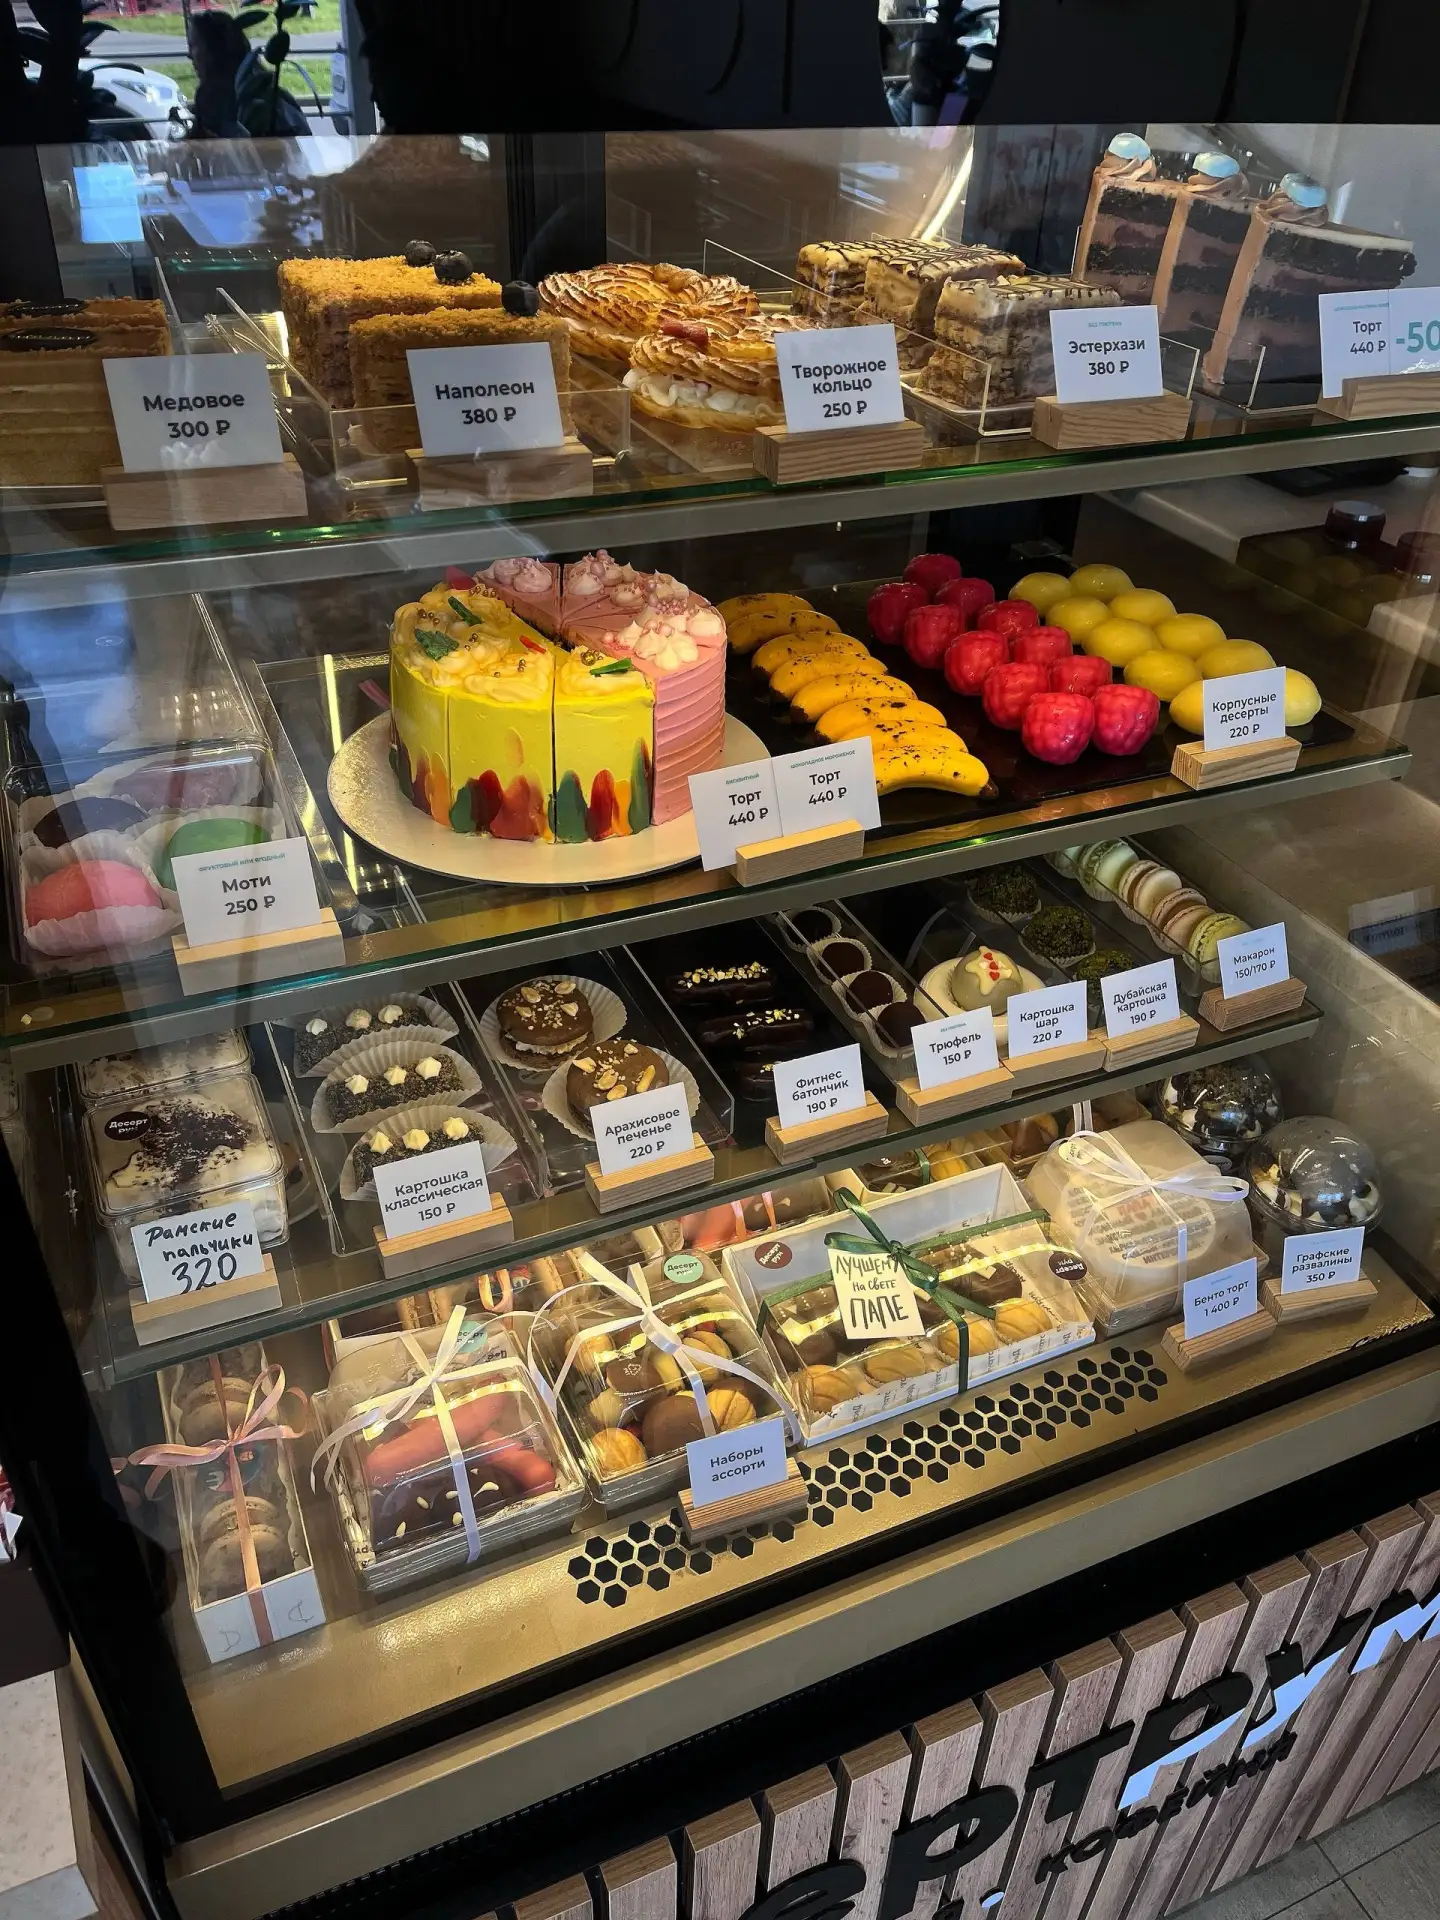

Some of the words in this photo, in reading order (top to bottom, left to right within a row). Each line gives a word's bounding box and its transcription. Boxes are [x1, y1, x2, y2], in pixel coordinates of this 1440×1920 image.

[1352, 321, 1382, 335] Торт
[1068, 339, 1146, 355] Эстерхази
[1350, 341, 1374, 355] 440
[792, 360, 887, 380] Творожное
[1088, 362, 1115, 376] 380
[435, 382, 535, 400] Наполеон
[813, 378, 872, 394] кольцо
[142, 393, 245, 412] Медовое
[823, 402, 852, 418] 250
[462, 408, 498, 425] 380
[167, 420, 209, 439] 300
[1212, 693, 1277, 713] Корпусные
[1220, 706, 1269, 724] десерты
[1229, 725, 1249, 739] 220
[809, 770, 841, 786] Торт
[729, 790, 762, 806] Торт
[808, 789, 834, 806] 440
[728, 810, 756, 826] 440
[221, 875, 272, 894] Моти
[224, 899, 258, 916] 250
[1233, 947, 1275, 965] Макарон
[1235, 962, 1268, 979] 150/170
[1113, 982, 1168, 1006] Дубайская
[1117, 993, 1166, 1013] картошка
[1020, 1004, 1075, 1022] Картошка
[1130, 1012, 1147, 1025] 190
[1035, 1017, 1059, 1029] шар
[929, 1033, 982, 1053] Трюфель
[1032, 1032, 1052, 1044] 220
[943, 1052, 961, 1066] 150
[796, 1070, 843, 1089] Фитнес
[792, 1079, 849, 1101] батончик
[807, 1100, 827, 1114] 190
[109, 1119, 148, 1129] Десерт
[605, 1109, 681, 1137] Арахисовое
[617, 1122, 672, 1145] печенье
[629, 1144, 653, 1159] 220
[395, 1170, 469, 1197] Картошка
[384, 1178, 484, 1213] классическая
[418, 1206, 442, 1221] 150
[162, 1233, 253, 1262] пальчики
[1296, 1248, 1350, 1263] Графские
[171, 1252, 237, 1295] 320
[667, 1262, 698, 1272] Десерт
[1292, 1257, 1353, 1275] развалины
[1306, 1273, 1325, 1284] 350
[1194, 1291, 1225, 1307] Бенто
[1226, 1280, 1249, 1293] торт
[850, 1294, 909, 1330] ПАПЕ
[710, 1446, 764, 1468] Наборы
[711, 1460, 766, 1482] ассорти
